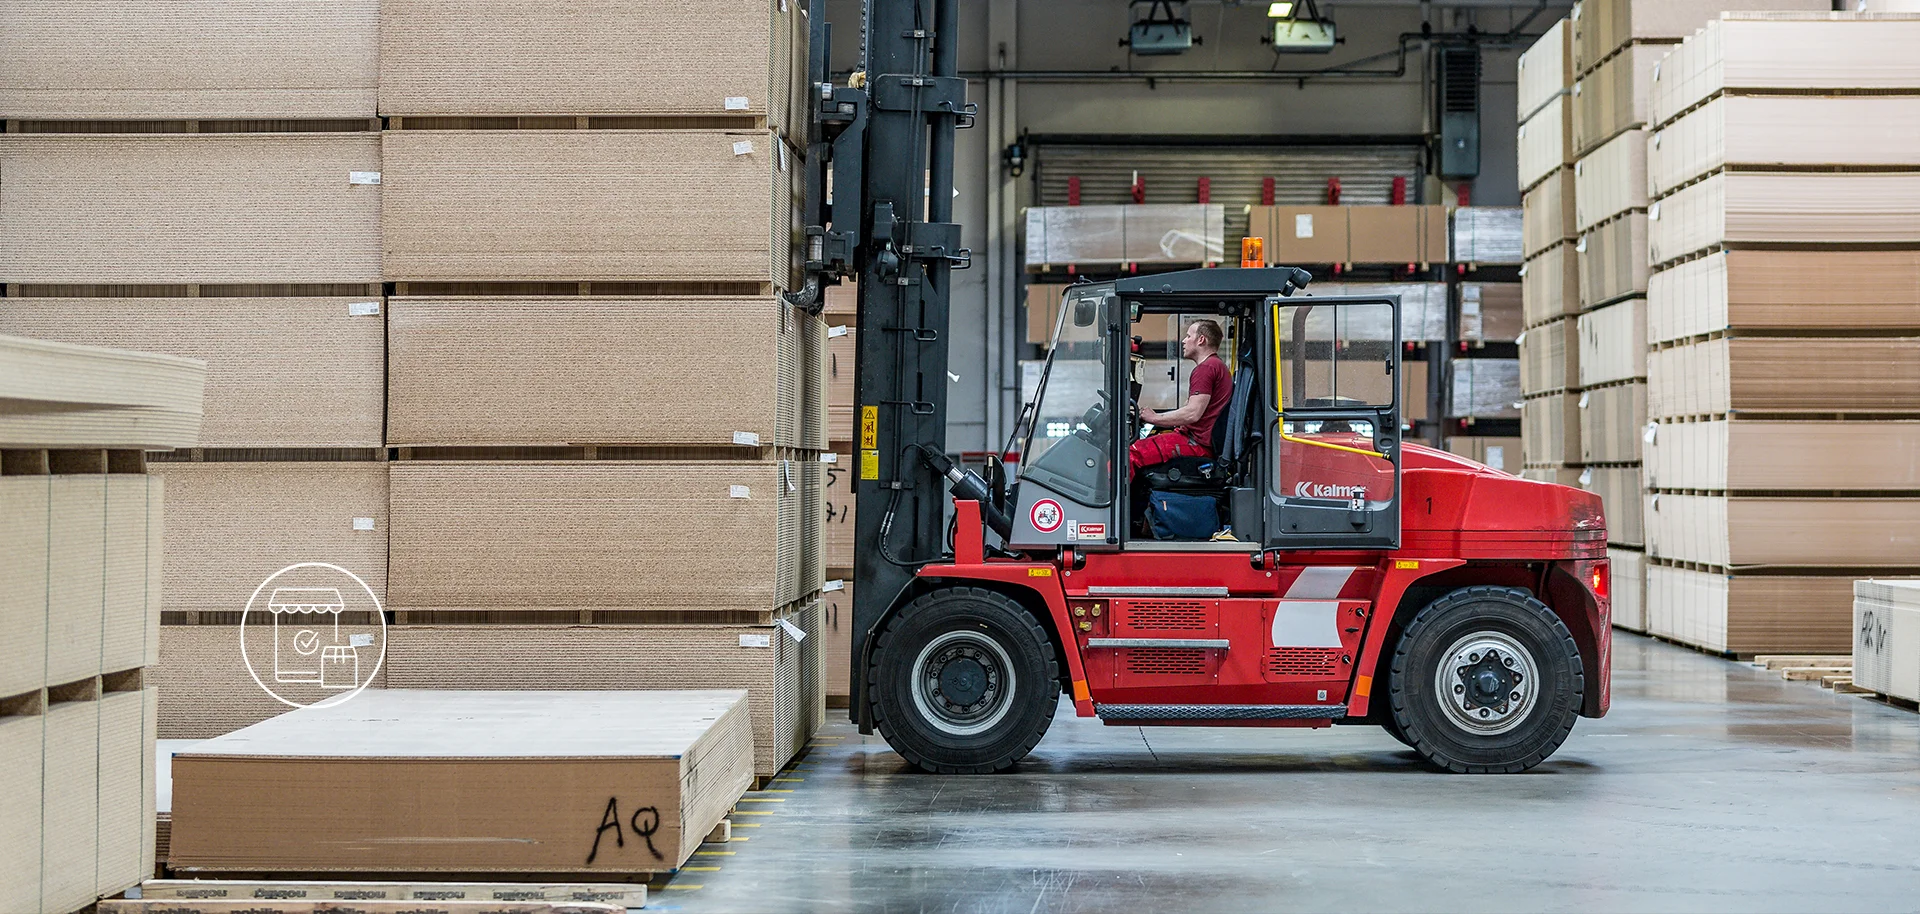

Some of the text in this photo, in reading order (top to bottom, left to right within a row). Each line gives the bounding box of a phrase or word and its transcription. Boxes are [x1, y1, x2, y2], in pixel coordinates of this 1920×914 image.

[1313, 484, 1366, 498] Kalm
[1425, 497, 1433, 515] 1
[586, 796, 664, 864] AQ
